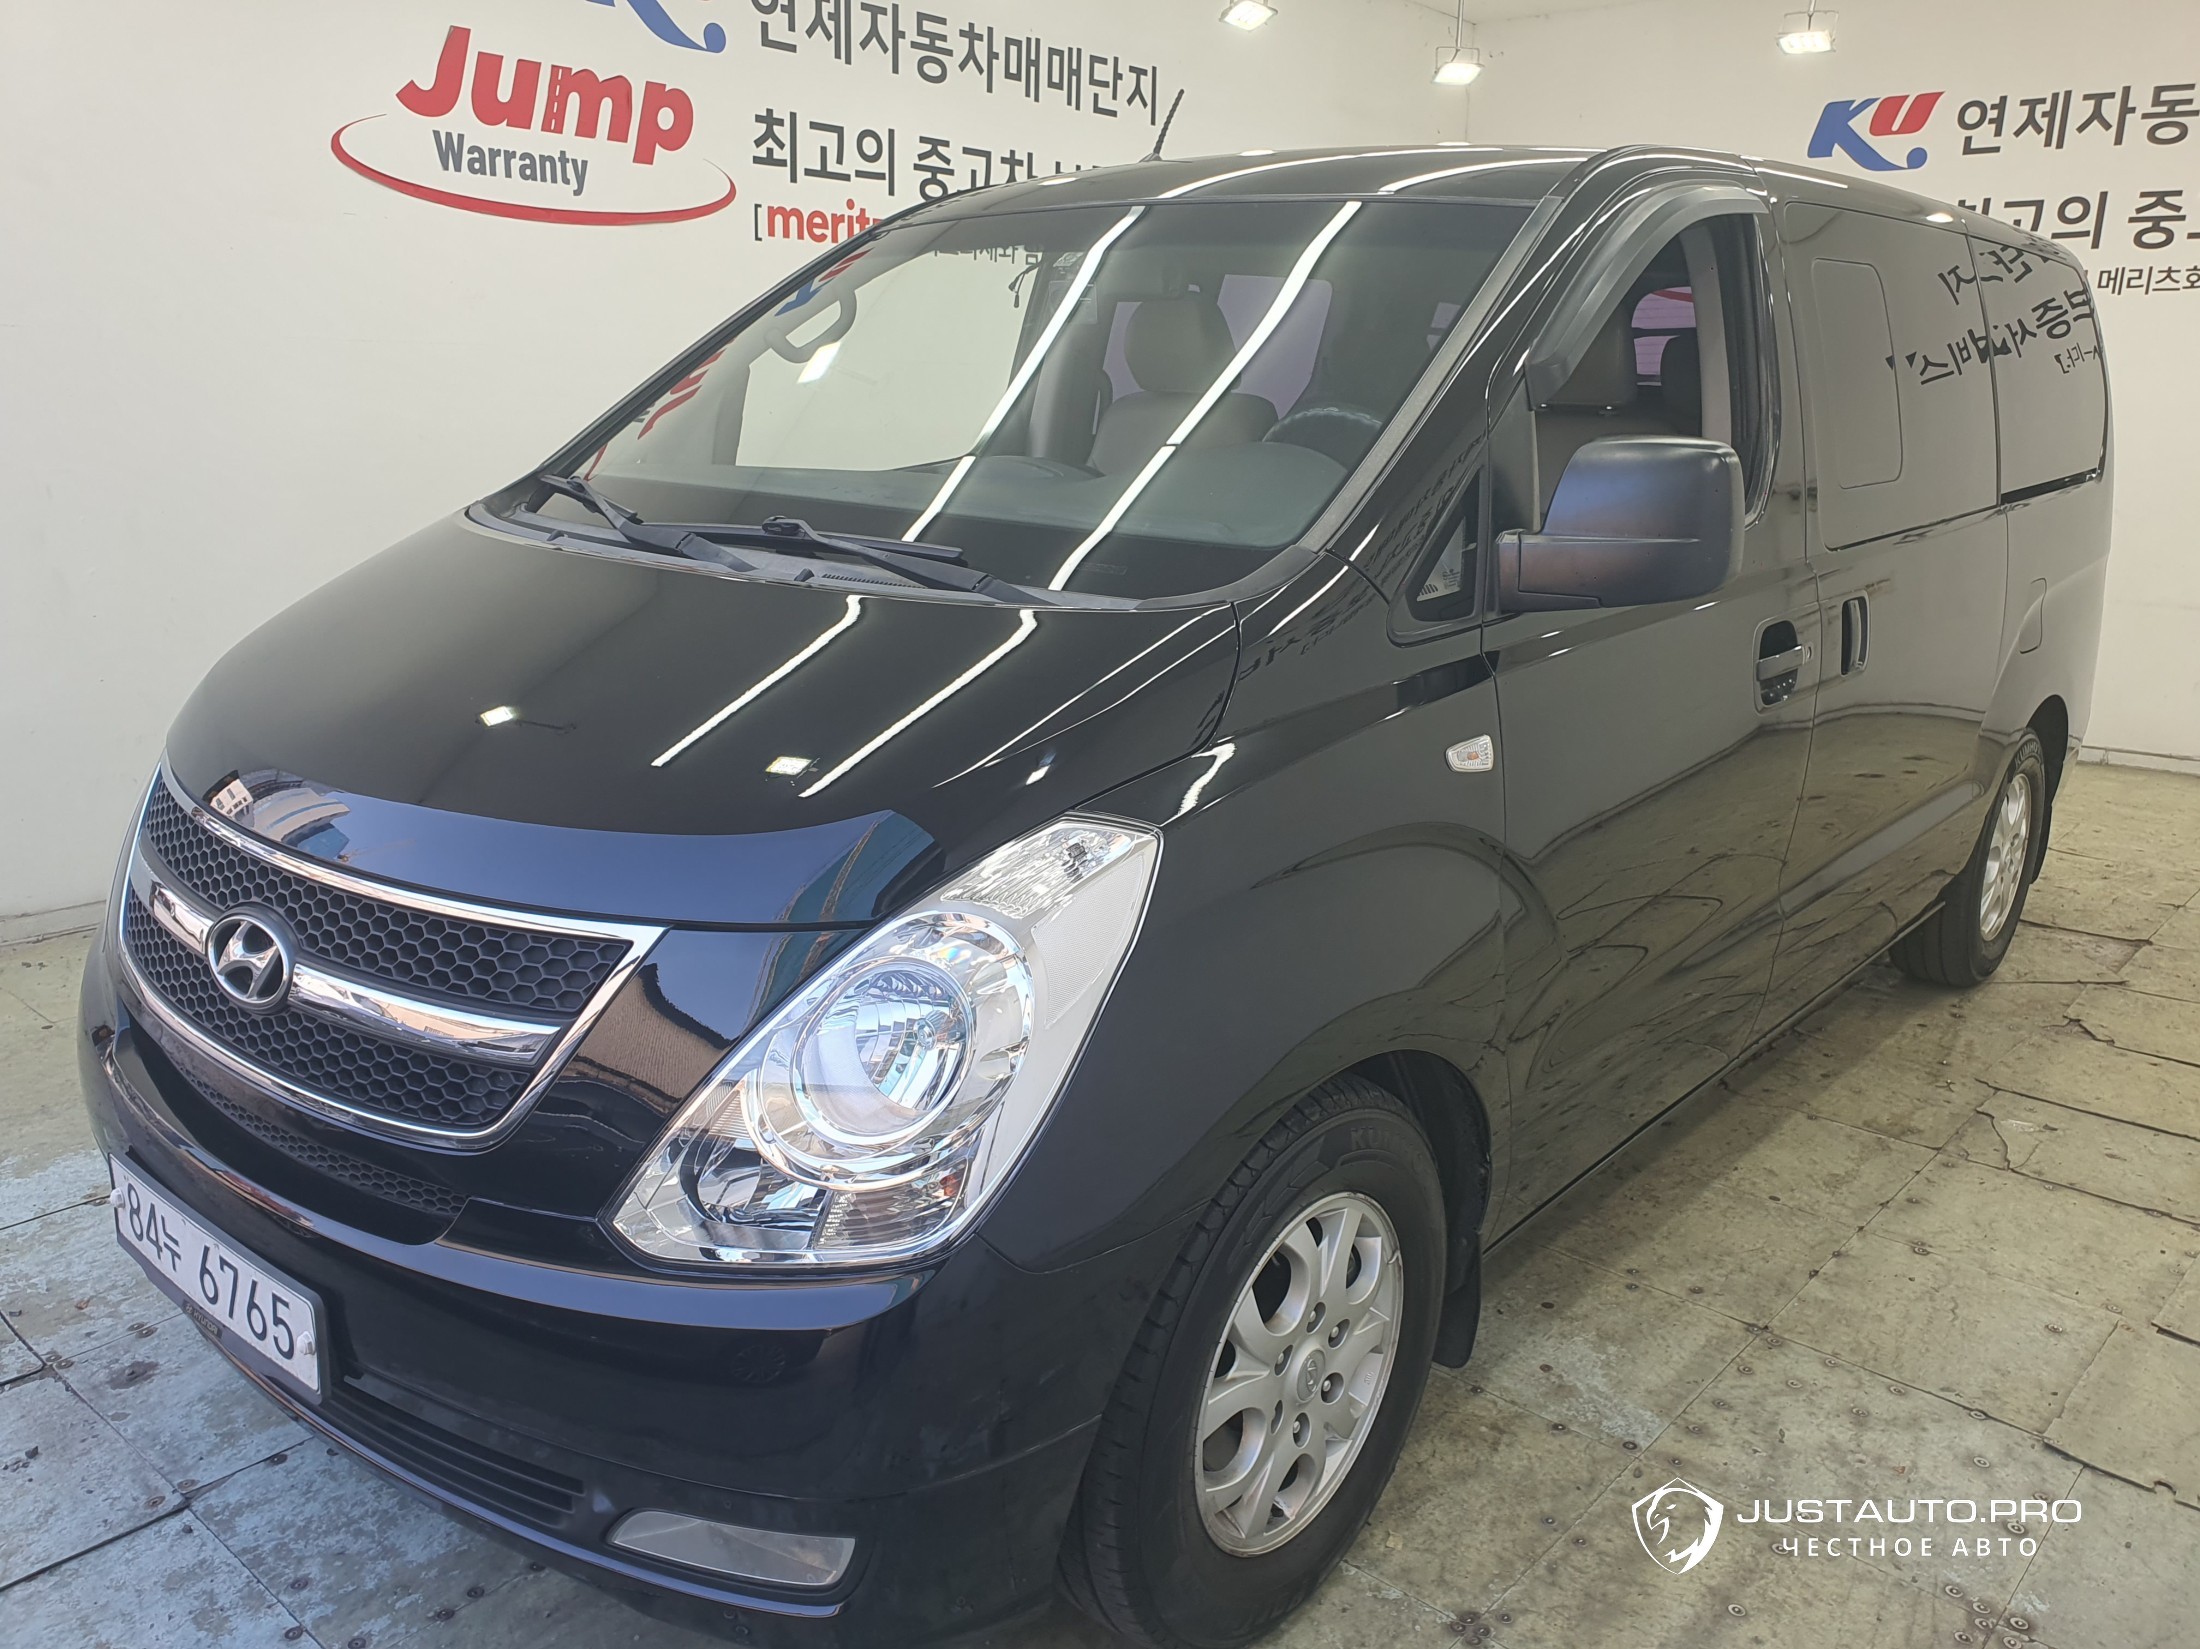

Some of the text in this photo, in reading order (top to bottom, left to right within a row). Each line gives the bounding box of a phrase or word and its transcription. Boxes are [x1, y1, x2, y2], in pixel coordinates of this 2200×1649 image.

[395, 25, 694, 165] Jump
[750, 0, 1158, 126] 연제자동차매매단지
[432, 130, 589, 196] Warranty
[752, 108, 896, 196] 최고의
[2127, 190, 2200, 250] 중
[127, 1183, 295, 1361] 84누 6765
